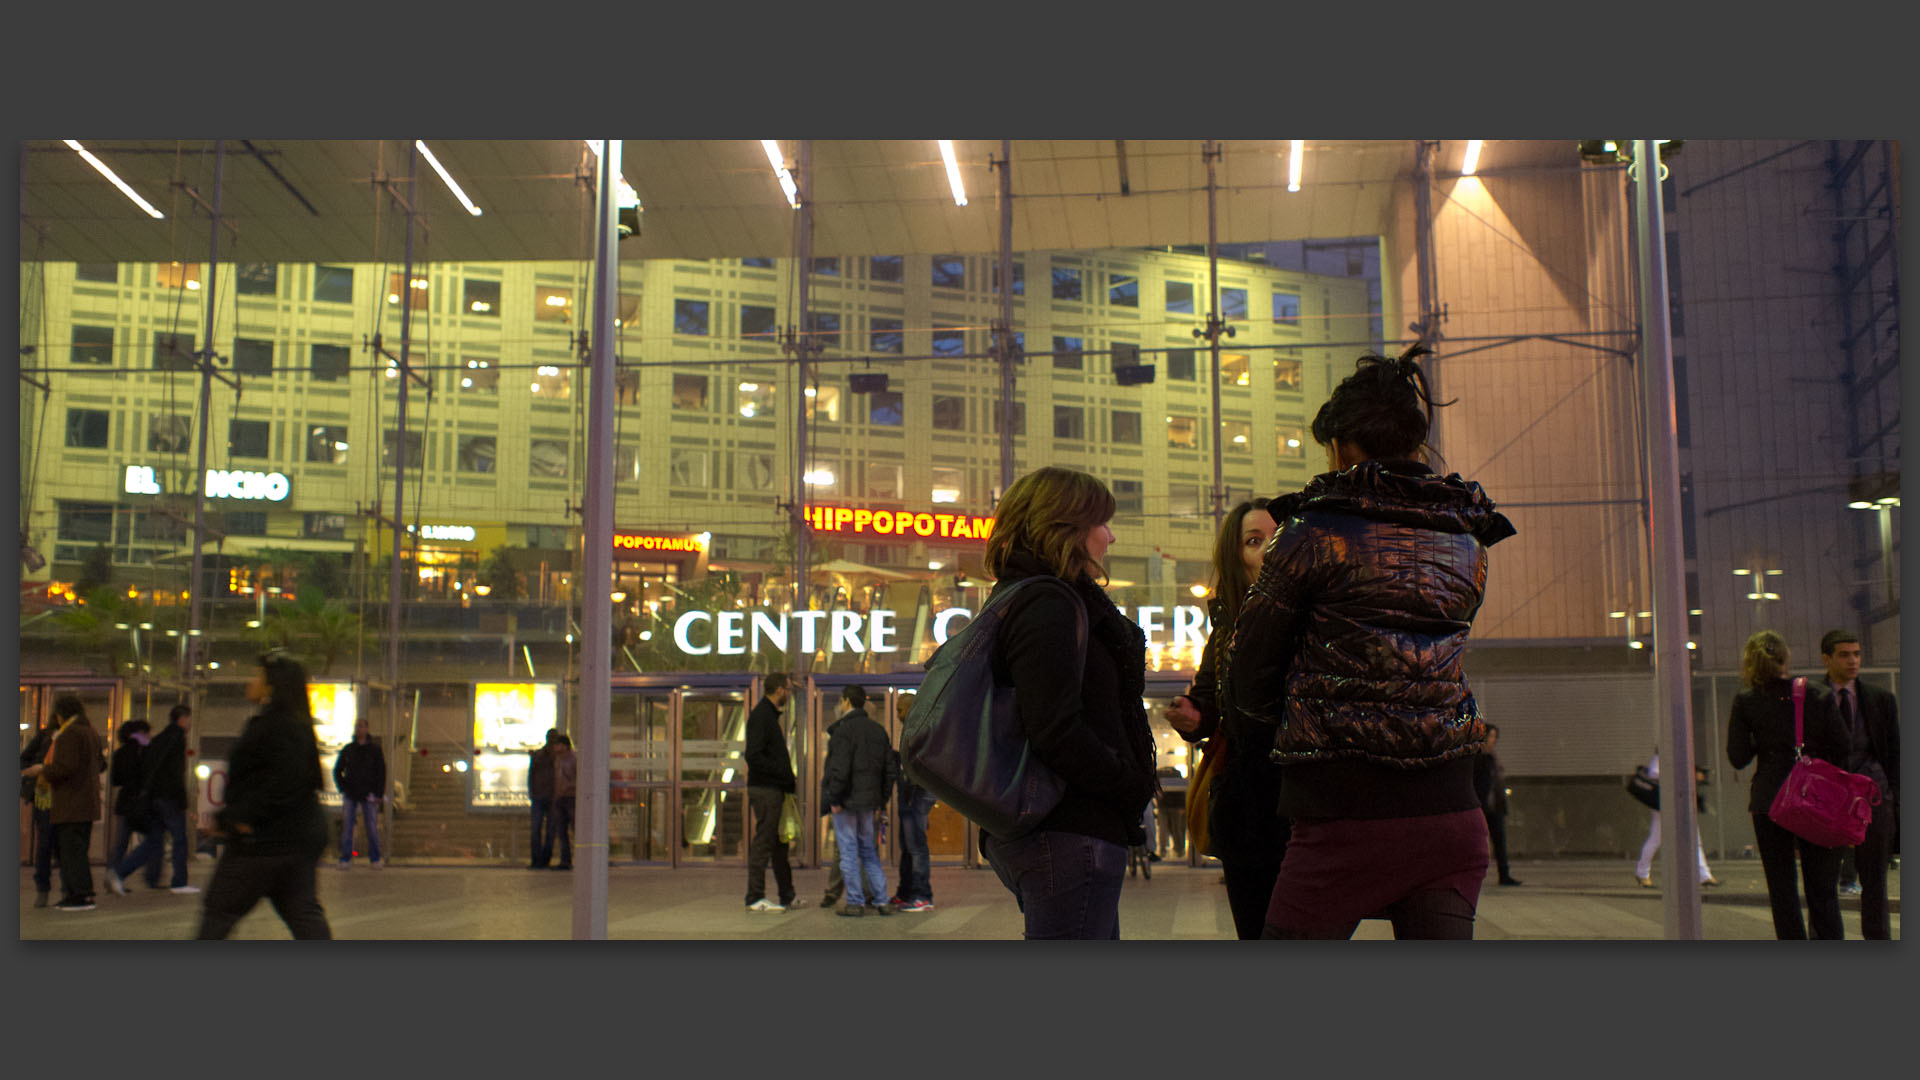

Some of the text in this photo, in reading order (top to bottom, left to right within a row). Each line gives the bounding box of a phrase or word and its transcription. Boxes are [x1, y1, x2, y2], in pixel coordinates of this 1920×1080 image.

[804, 506, 996, 539] HIPPOPOTAM
[612, 533, 704, 552] POPOTAMUS
[673, 609, 897, 656] CENTRE
